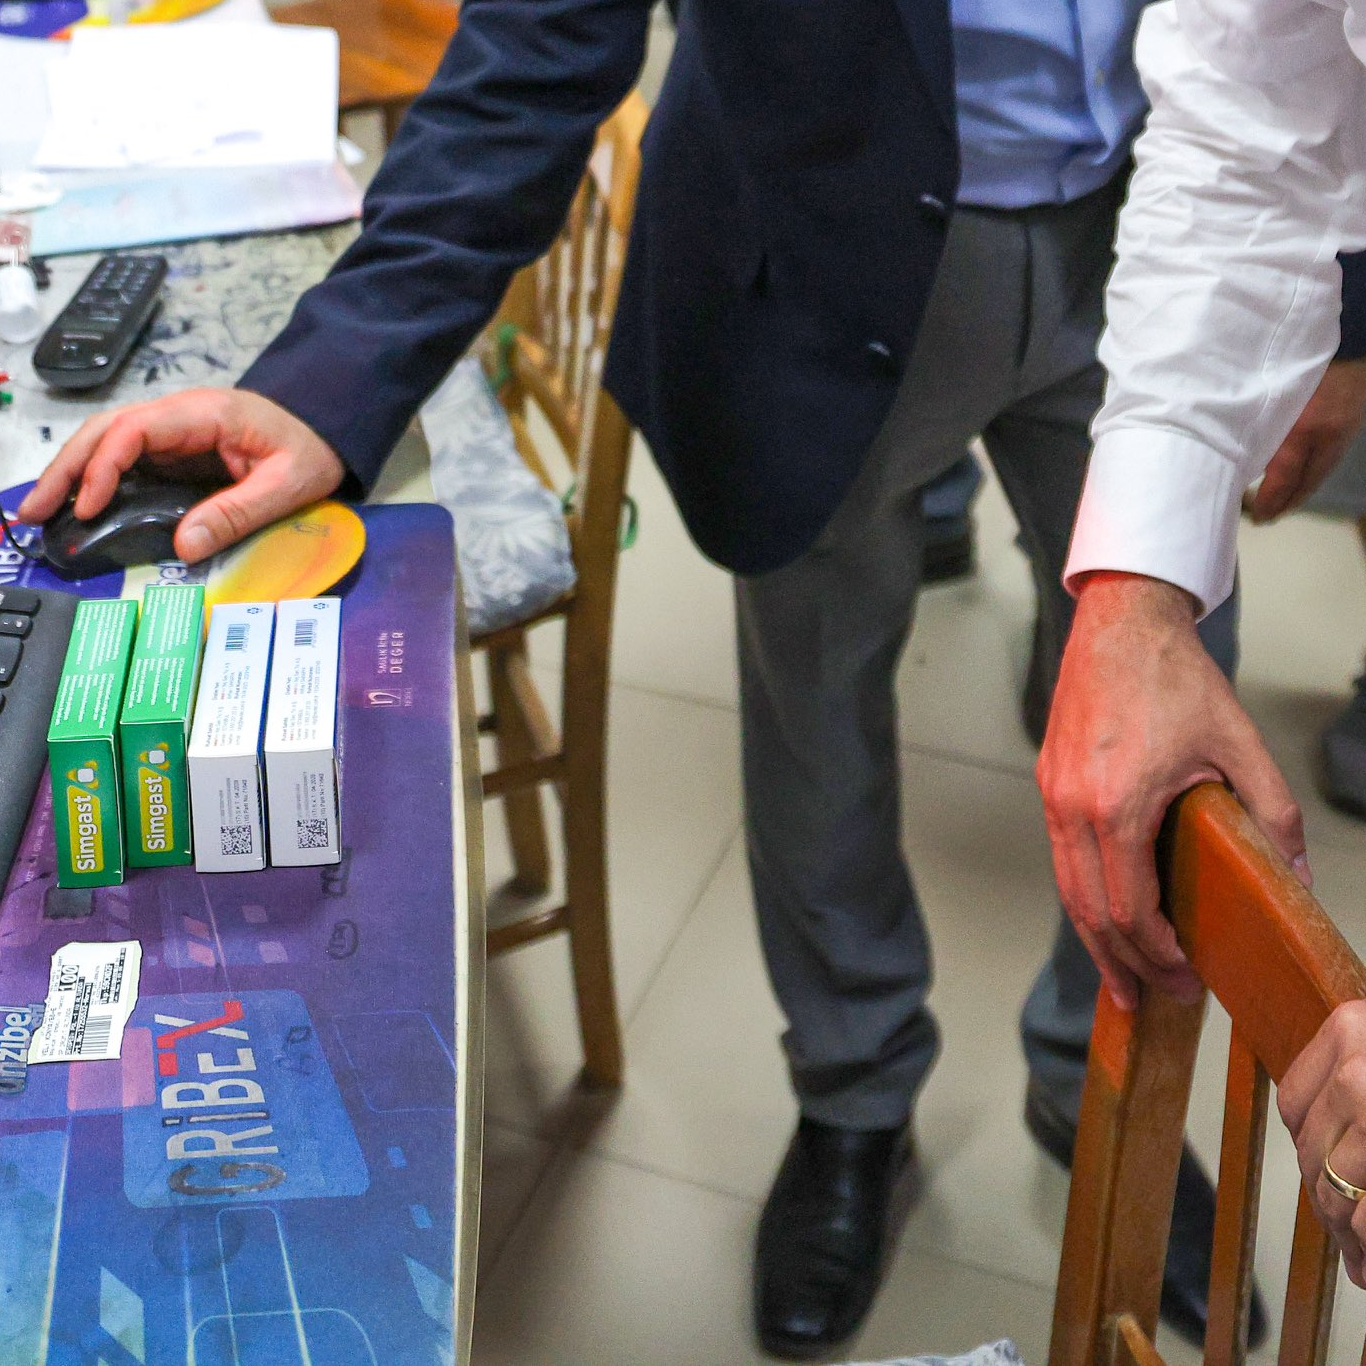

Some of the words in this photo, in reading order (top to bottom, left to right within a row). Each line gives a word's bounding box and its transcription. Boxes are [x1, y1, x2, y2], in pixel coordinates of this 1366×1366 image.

[73, 794, 97, 871] Simgast
[145, 776, 166, 850] Simgast
[58, 965, 78, 992] 100
